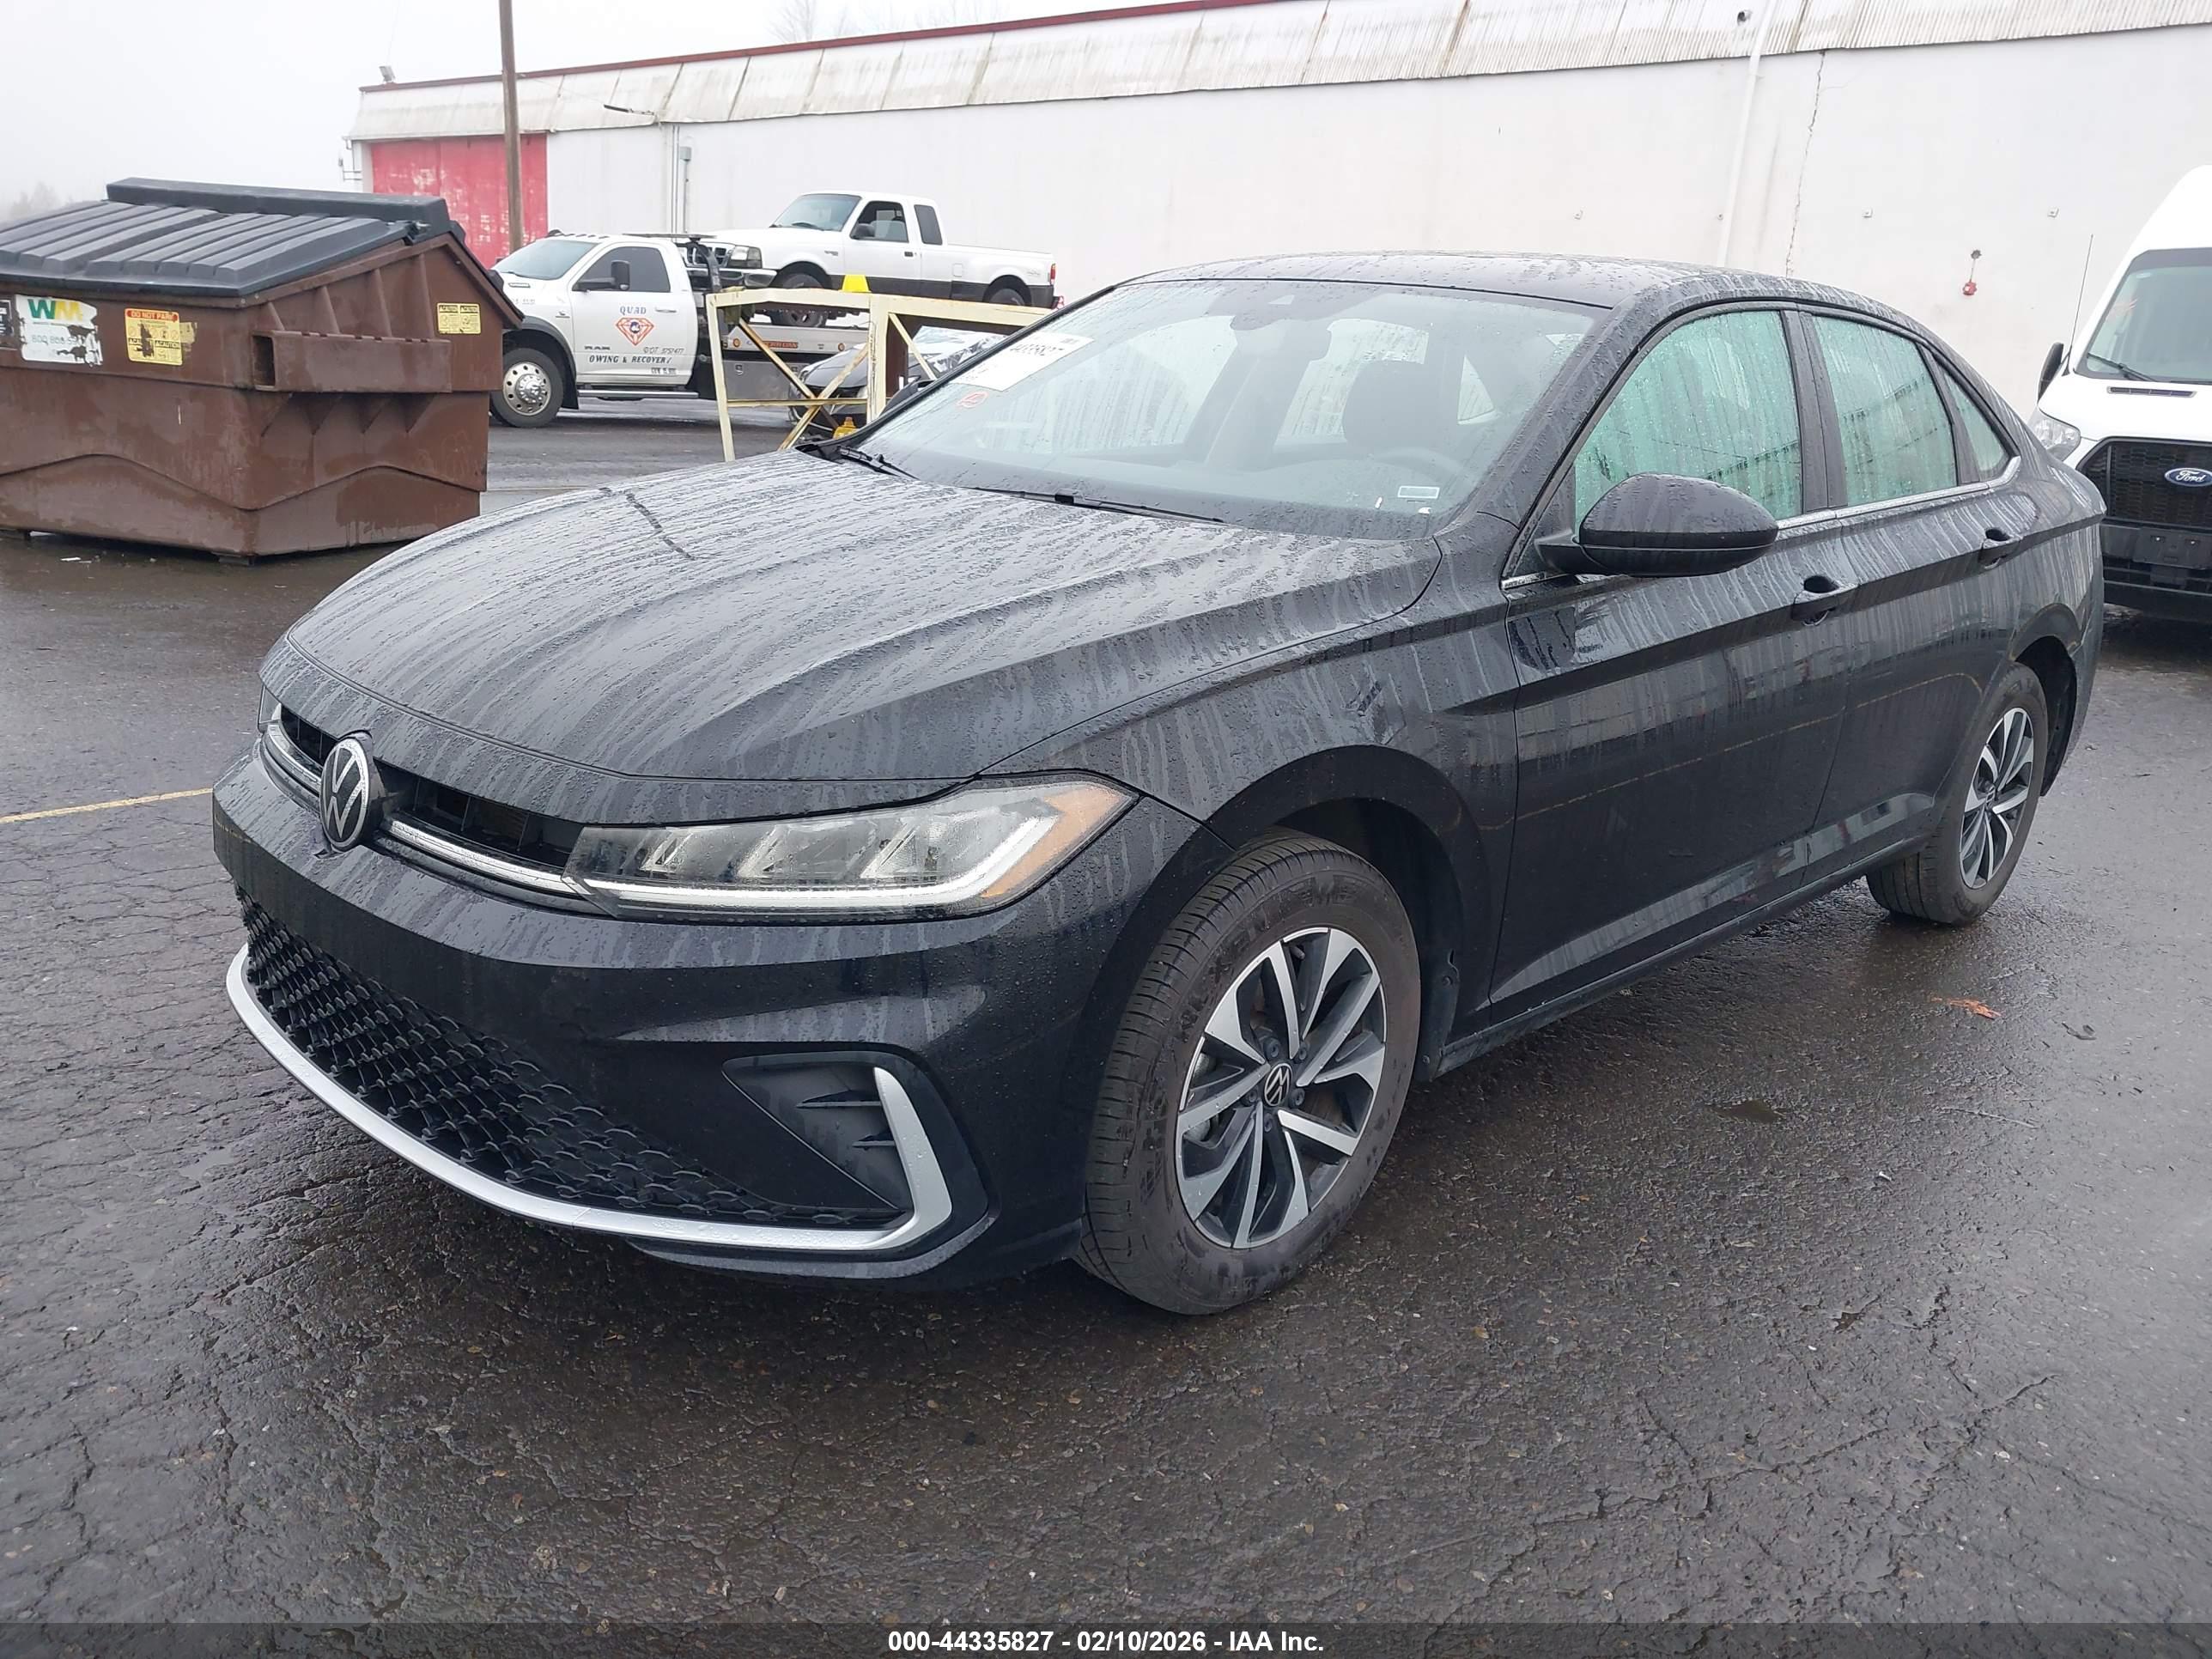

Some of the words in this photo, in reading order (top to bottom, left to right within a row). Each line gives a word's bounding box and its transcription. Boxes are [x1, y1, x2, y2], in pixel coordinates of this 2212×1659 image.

[27, 299, 82, 320] WM
[620, 306, 647, 315] QUAD
[2175, 470, 2207, 483] Ford
